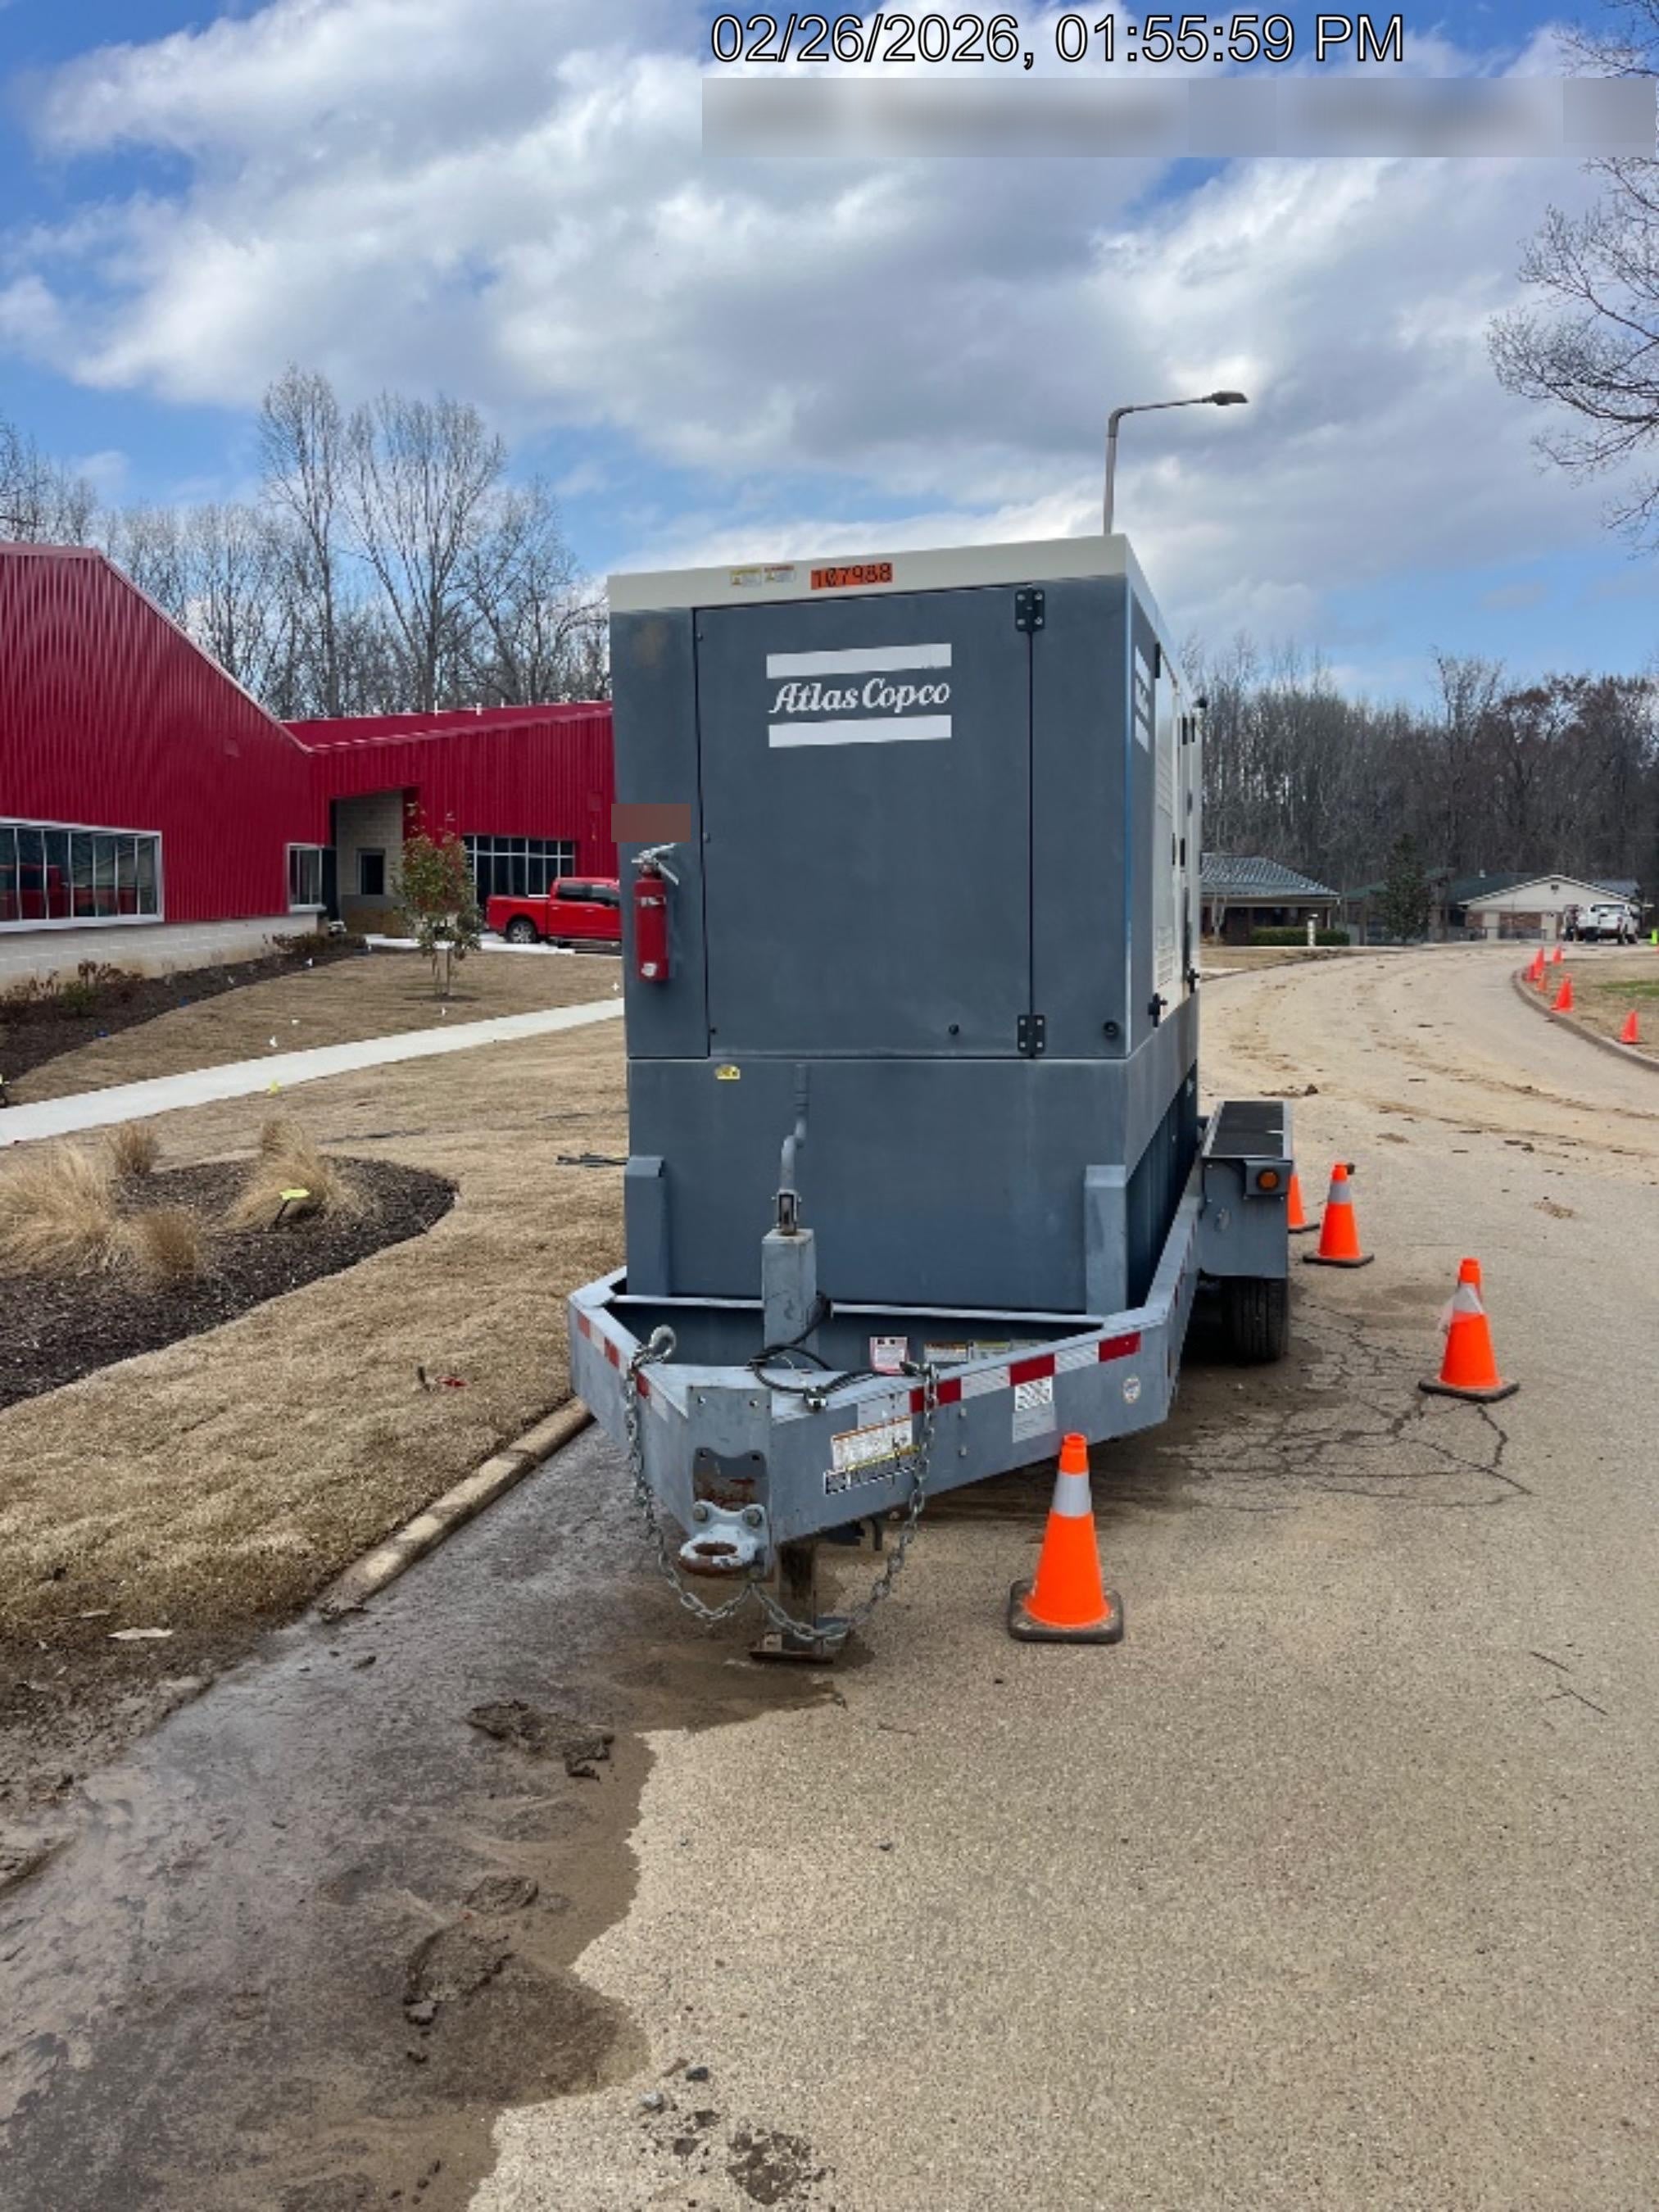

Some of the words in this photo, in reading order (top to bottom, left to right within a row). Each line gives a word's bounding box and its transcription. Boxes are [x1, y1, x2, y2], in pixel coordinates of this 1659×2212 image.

[813, 562, 891, 588] 107988
[768, 682, 859, 714] Atlas
[862, 678, 951, 714] Copco
